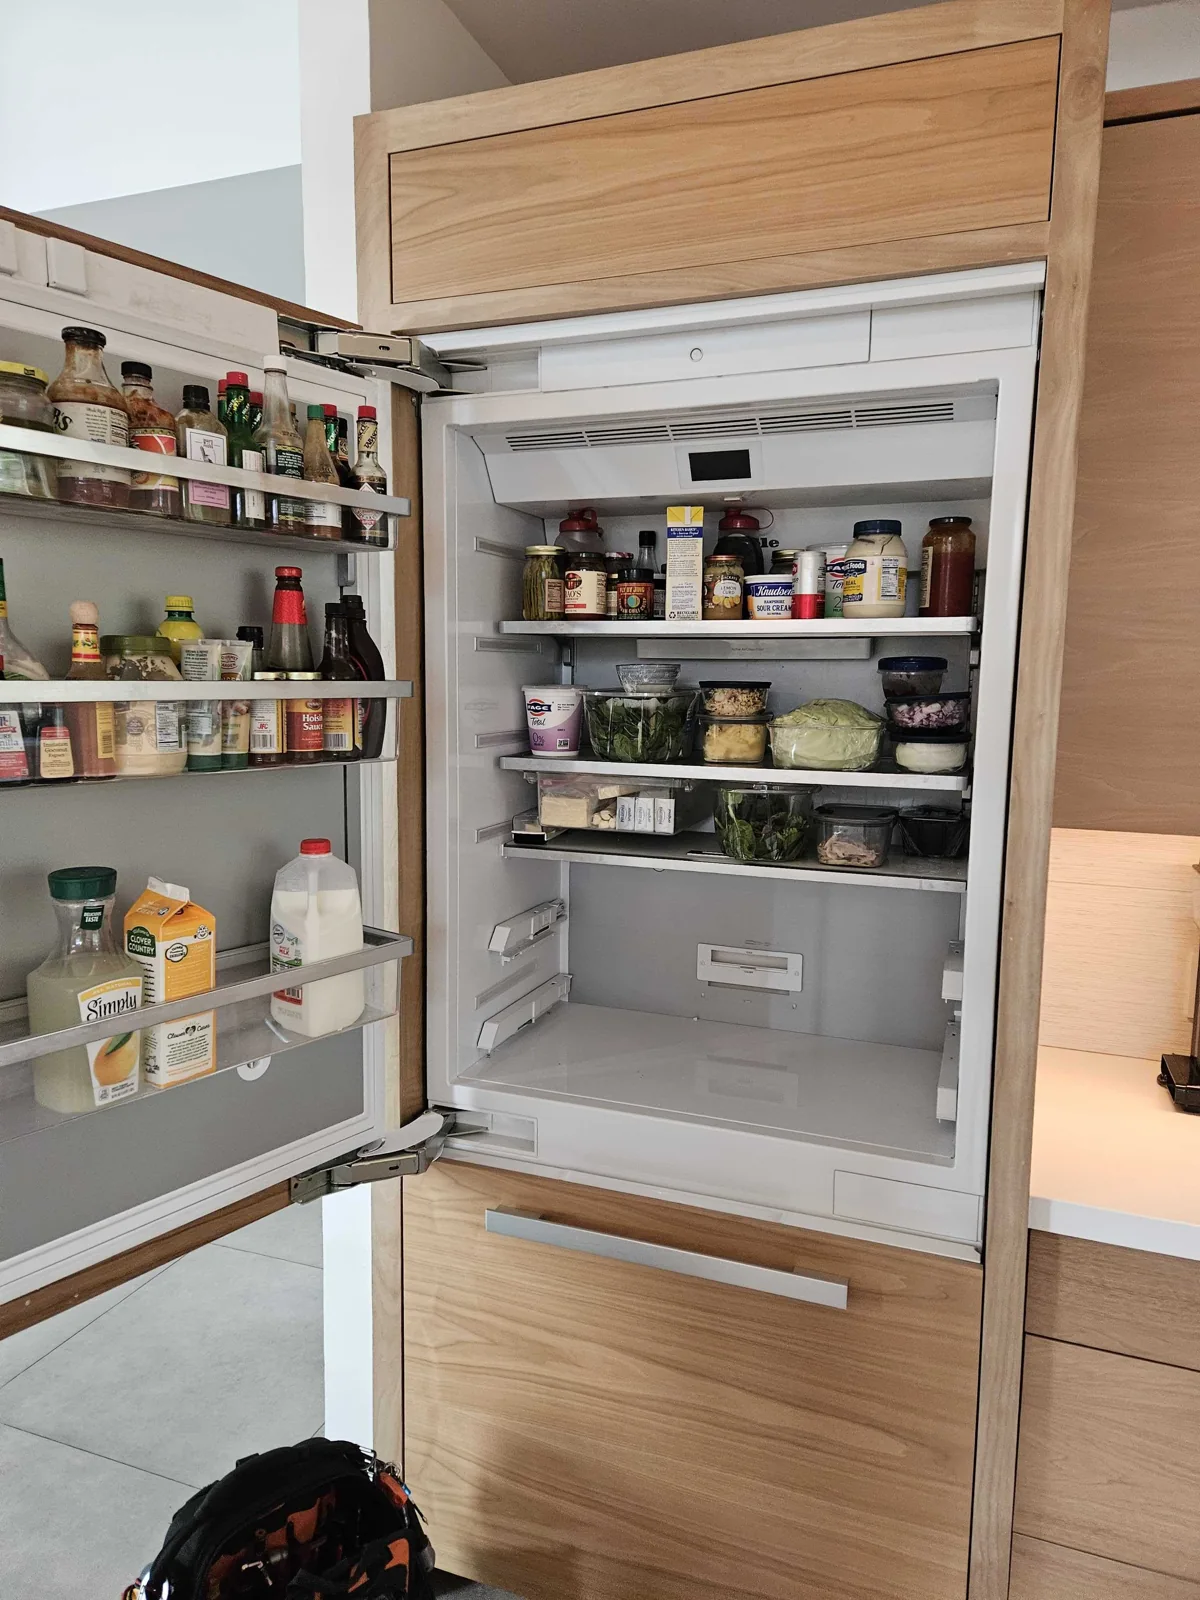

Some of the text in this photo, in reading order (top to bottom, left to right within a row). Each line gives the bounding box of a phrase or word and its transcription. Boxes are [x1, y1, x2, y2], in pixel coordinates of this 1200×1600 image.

[756, 604, 772, 612] SOUR
[530, 717, 546, 726] Total
[130, 935, 152, 947] CLOVER
[128, 942, 155, 956] COUNTRY
[86, 991, 137, 1022] Simply
